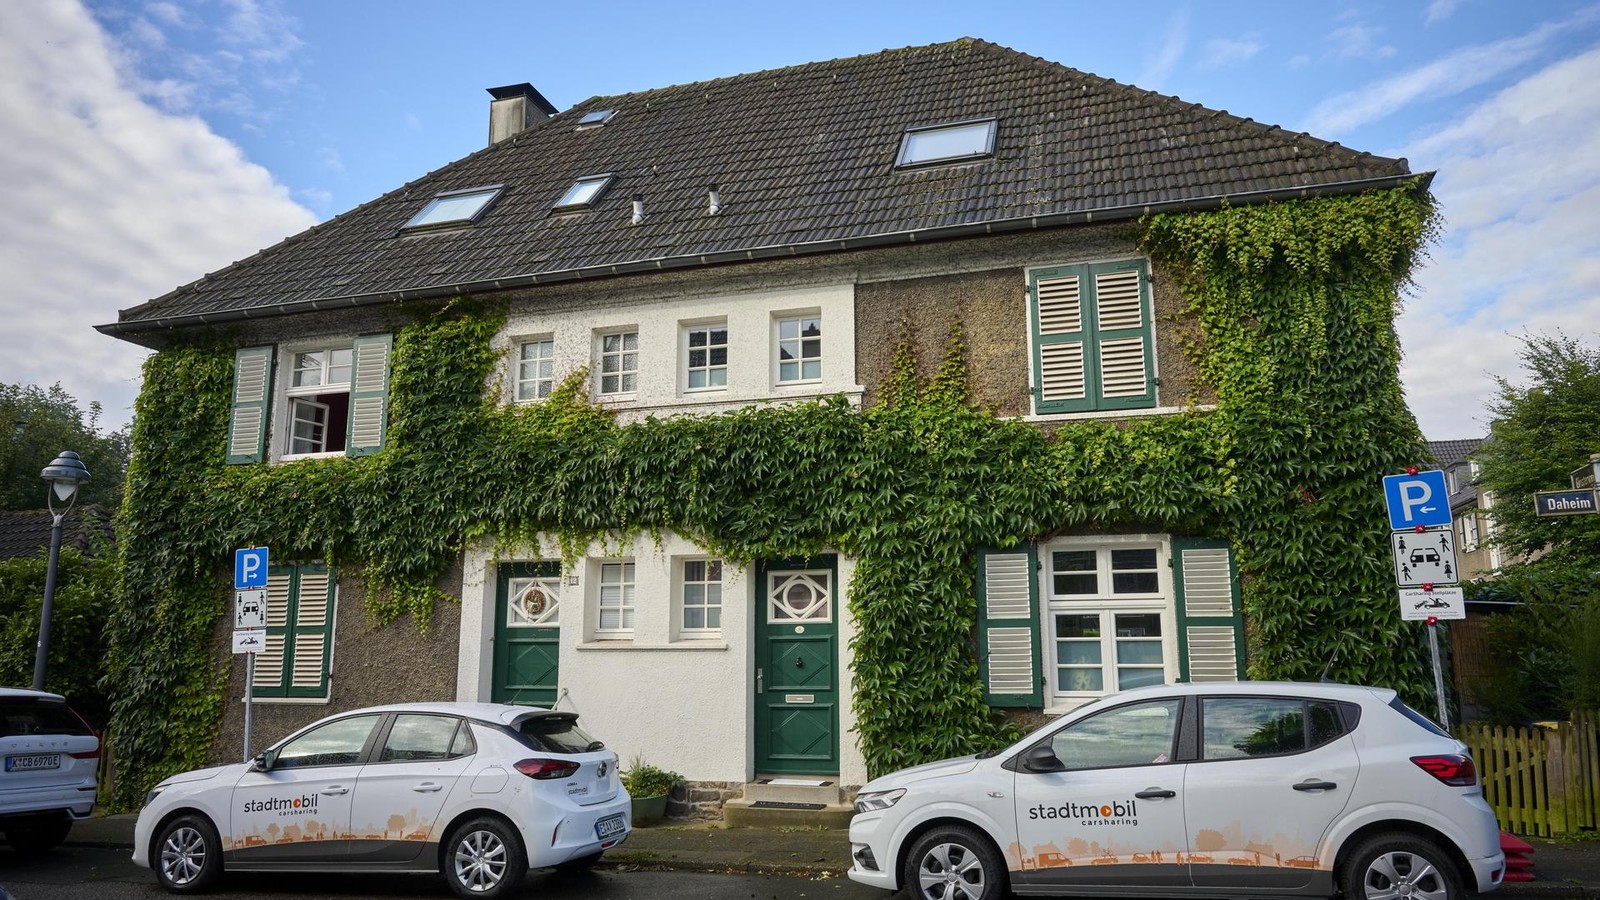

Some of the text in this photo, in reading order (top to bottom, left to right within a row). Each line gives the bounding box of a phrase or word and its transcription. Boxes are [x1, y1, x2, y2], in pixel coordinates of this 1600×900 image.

[1398, 480, 1432, 522] P
[1547, 497, 1591, 510] Daheim
[242, 553, 261, 583] P
[244, 793, 318, 812] stadtmobil
[279, 807, 318, 816] carsharing
[1029, 800, 1138, 820] stadtmobil
[1081, 817, 1139, 827] carsharing
